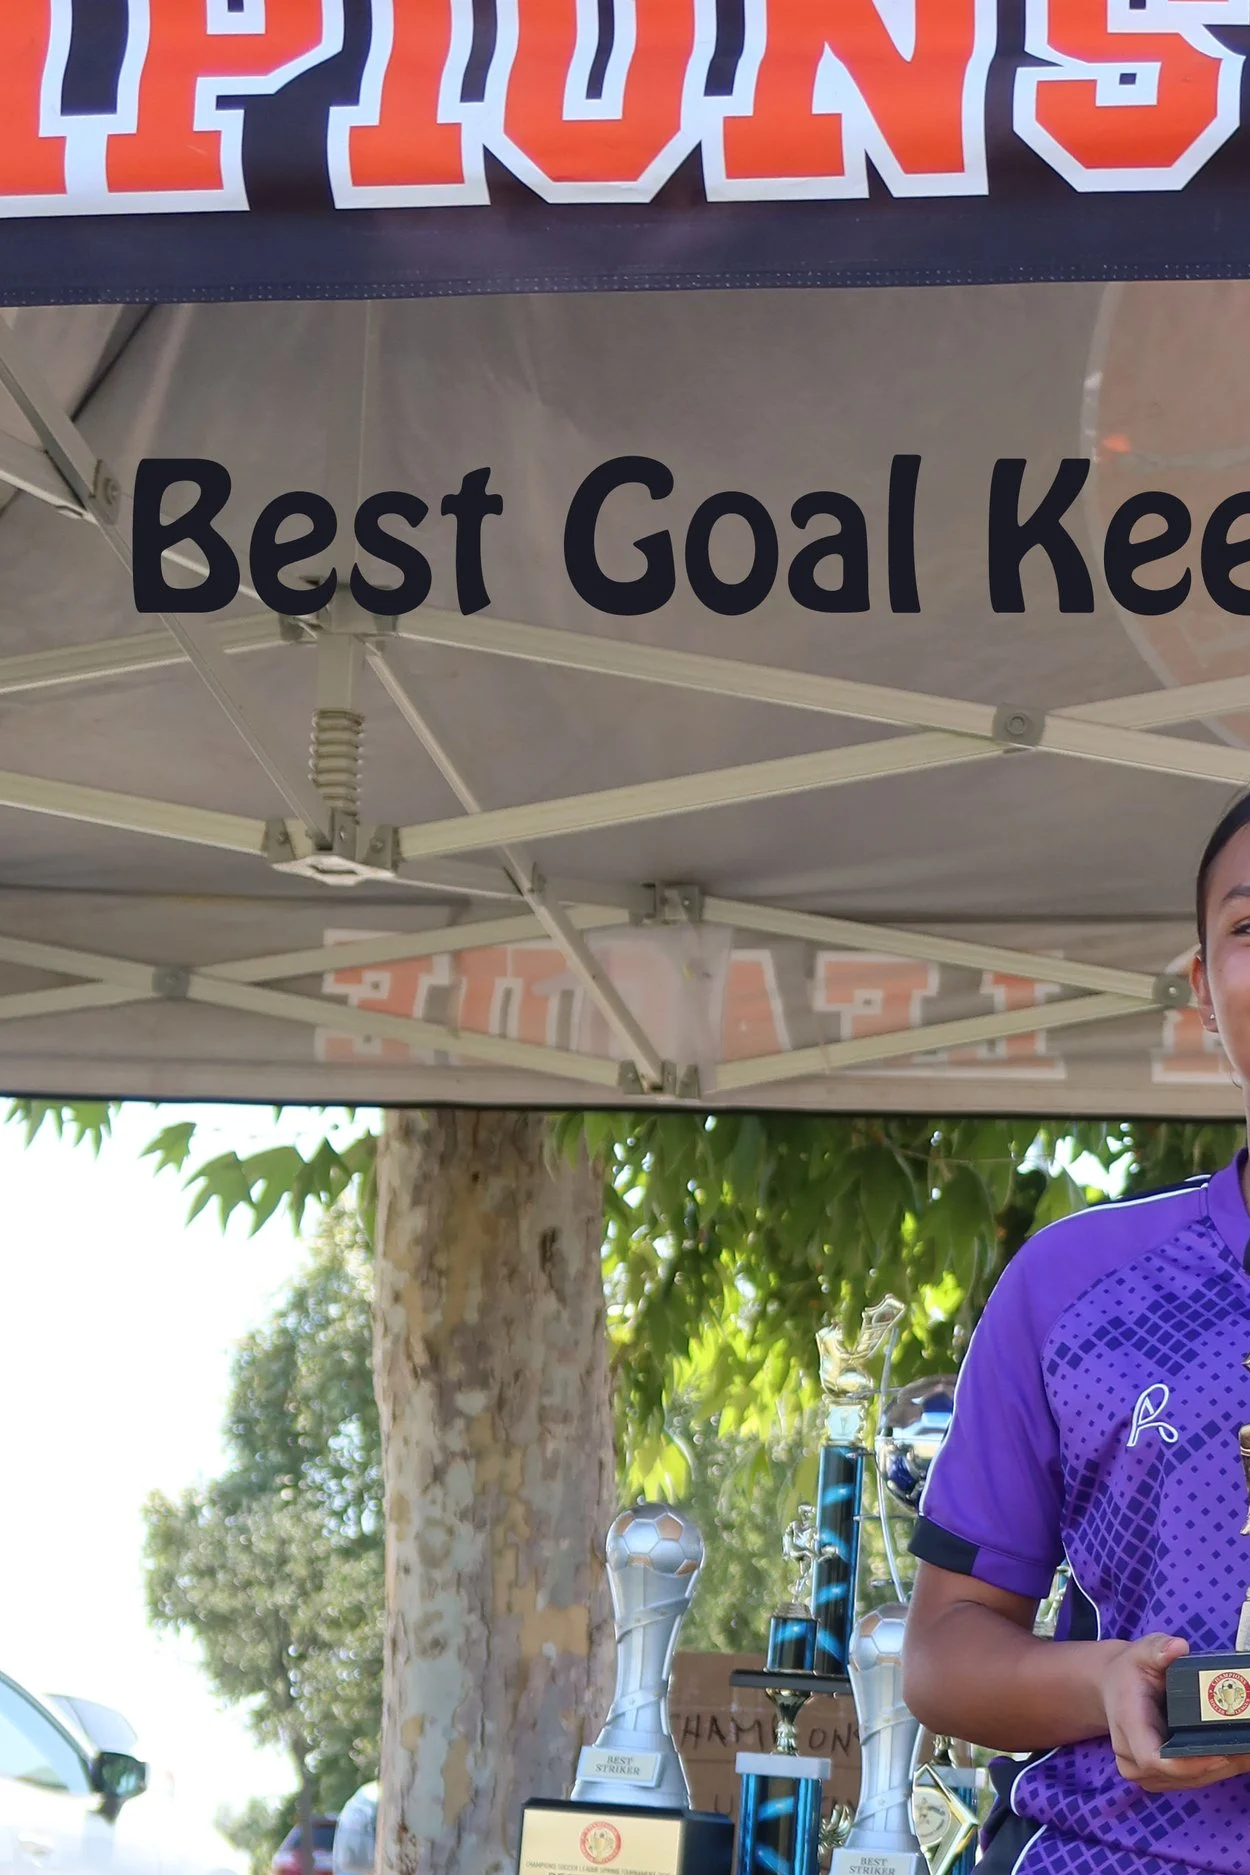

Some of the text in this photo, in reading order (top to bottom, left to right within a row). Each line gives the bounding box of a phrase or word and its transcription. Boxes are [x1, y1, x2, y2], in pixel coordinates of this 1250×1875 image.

[0, 0, 1250, 212] PIONS
[606, 1756, 634, 1767] BEST
[595, 1763, 641, 1776] STRIKER
[859, 1856, 888, 1867] BEST
